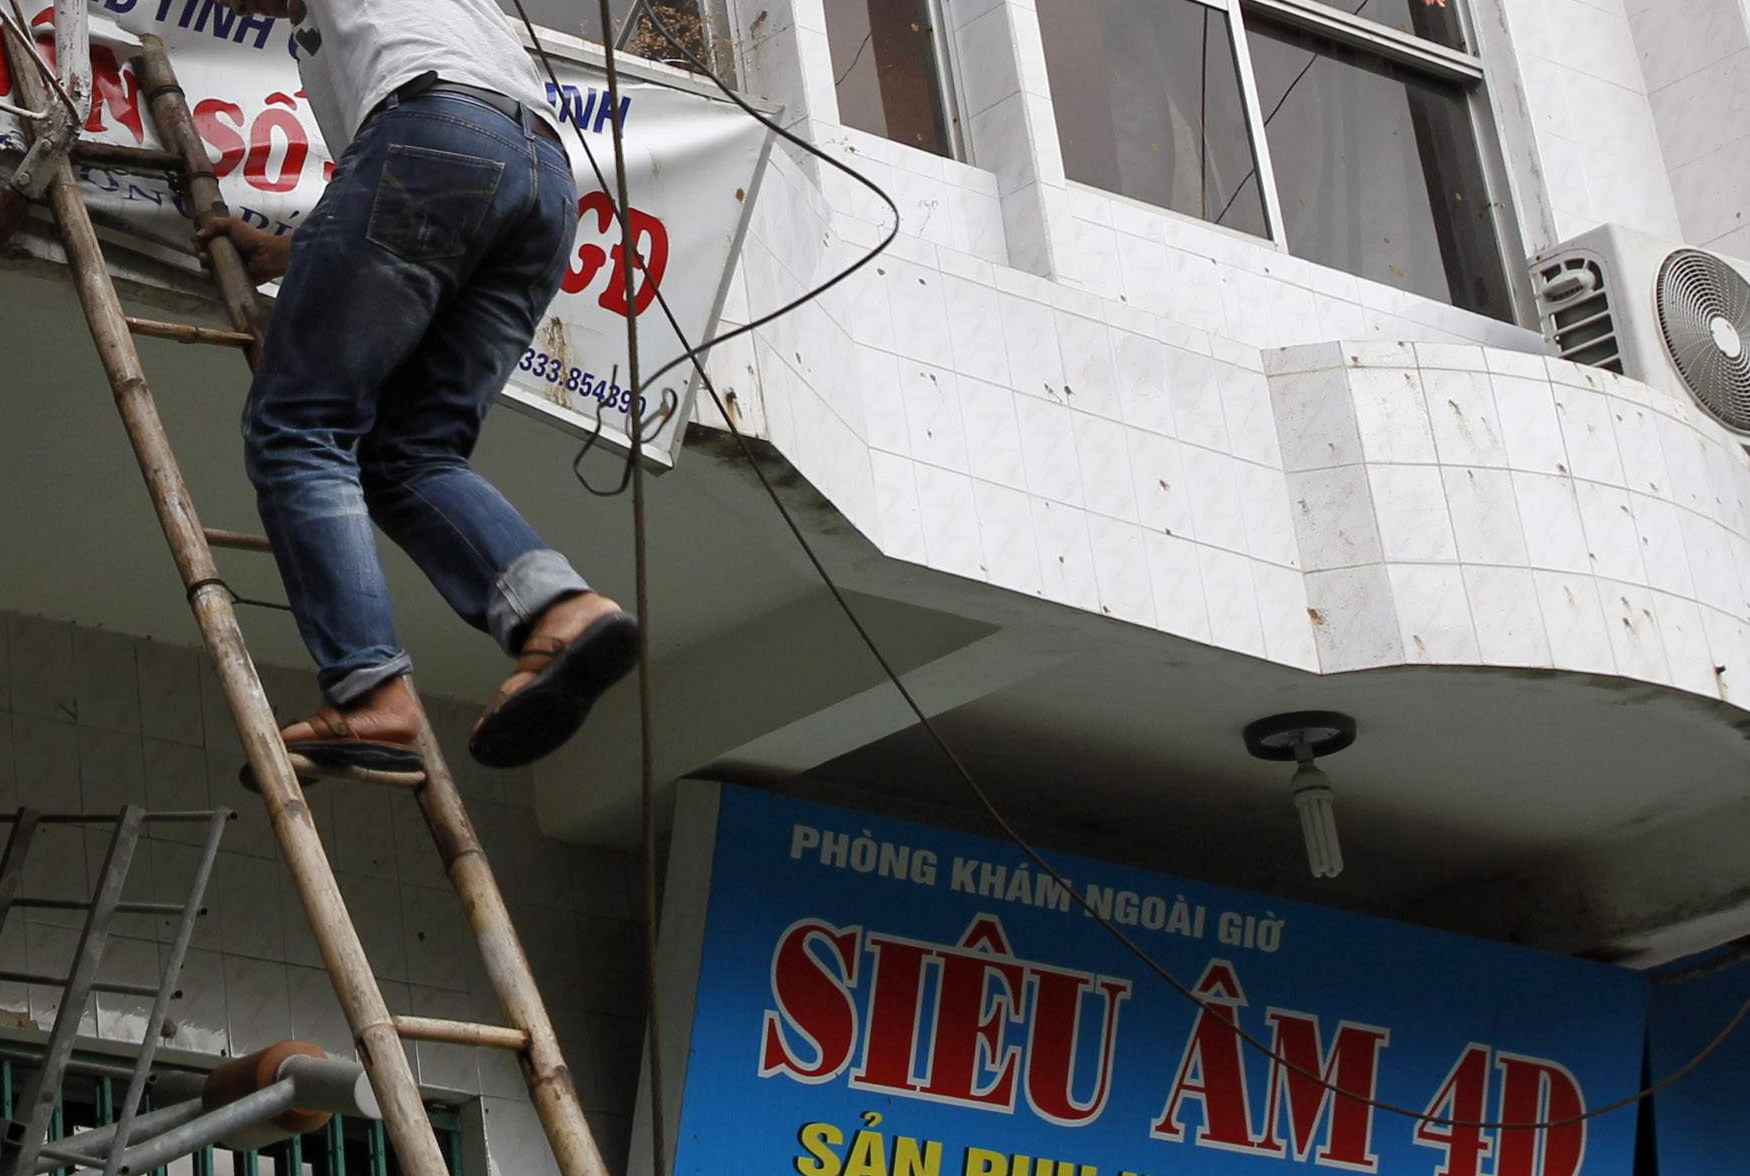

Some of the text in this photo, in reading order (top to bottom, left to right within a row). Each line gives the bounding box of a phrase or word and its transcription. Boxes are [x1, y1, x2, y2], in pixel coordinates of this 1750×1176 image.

[790, 823, 1286, 954] PHÒNG KHÁM NGOÀI GIỜ
[758, 912, 1588, 1176] SIÊU ÂM 4D
